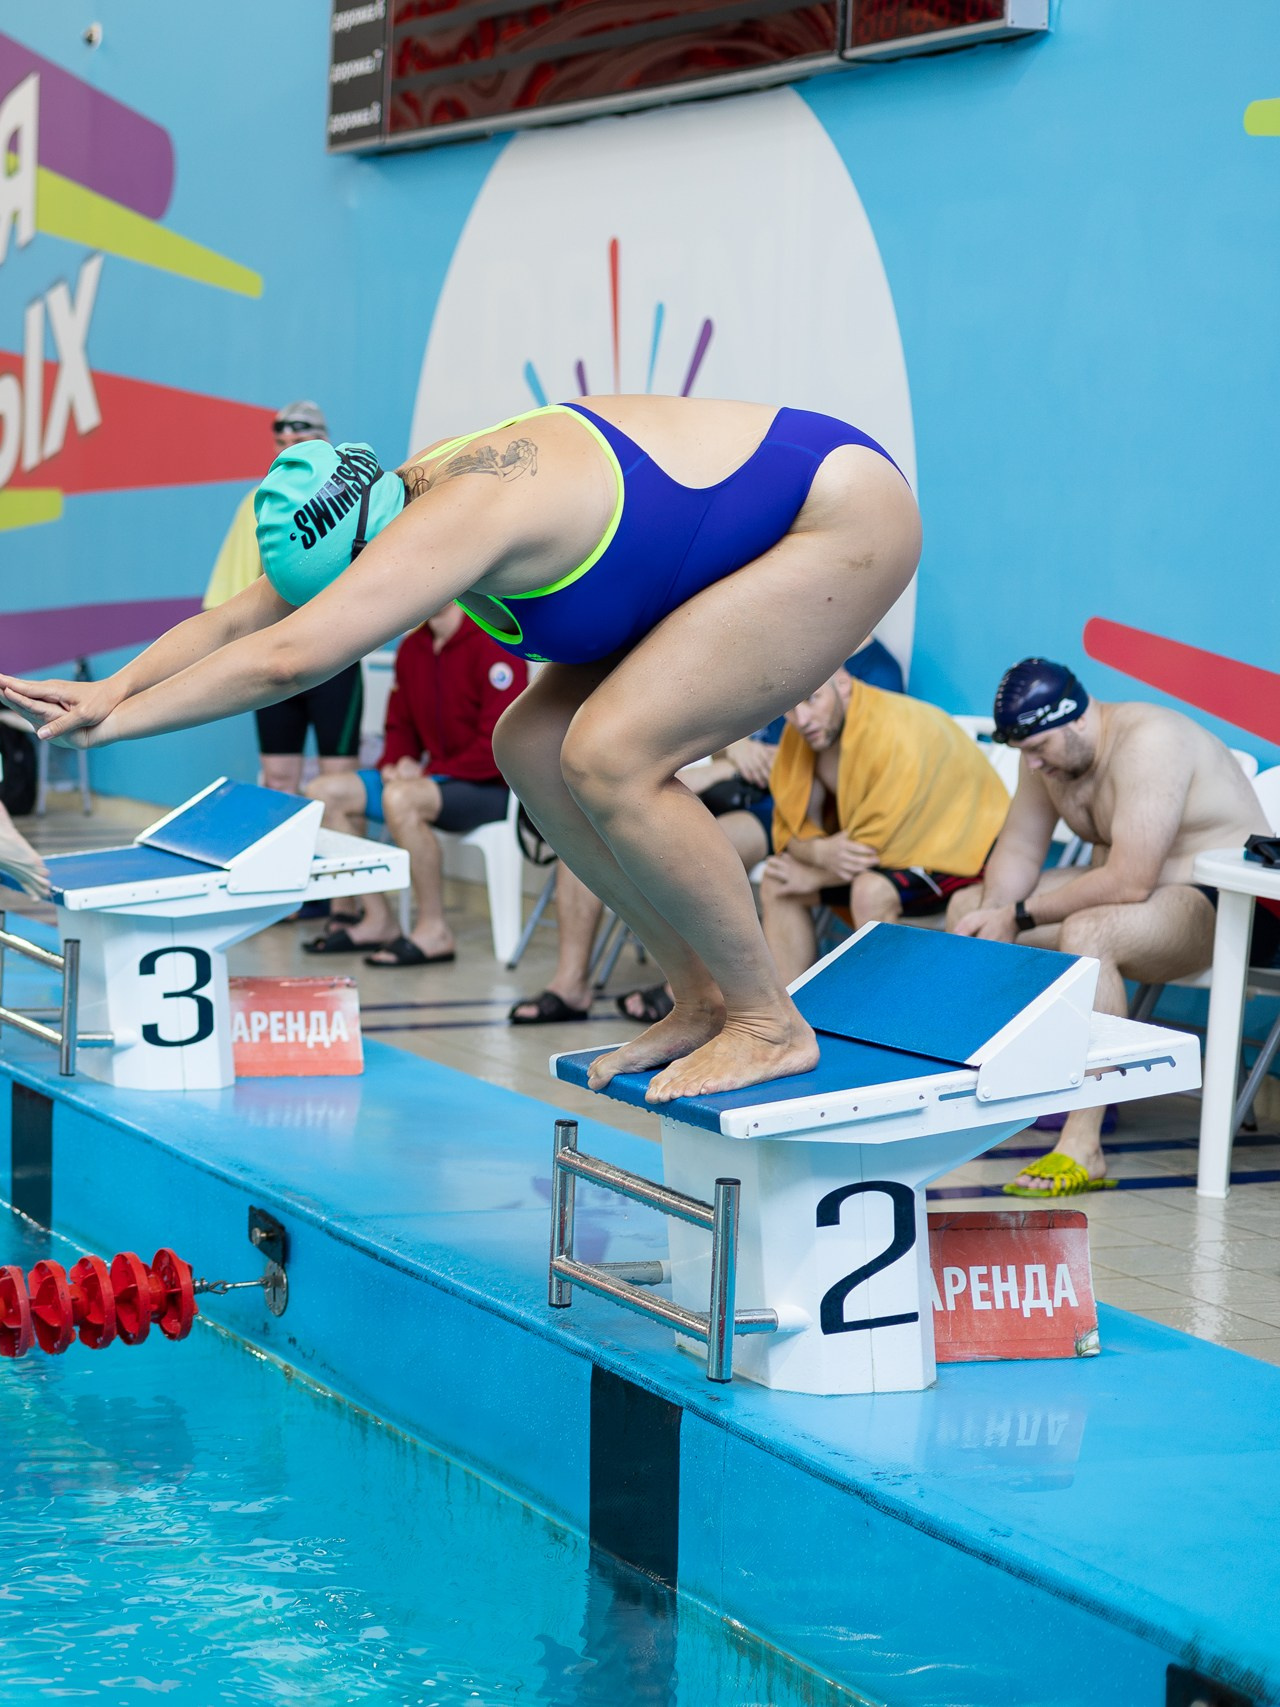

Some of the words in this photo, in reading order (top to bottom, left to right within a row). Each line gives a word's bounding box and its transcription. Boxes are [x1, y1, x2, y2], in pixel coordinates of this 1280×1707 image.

[138, 946, 215, 1047] 3
[232, 1010, 350, 1049] АРЕНДА
[816, 1180, 919, 1335] 2
